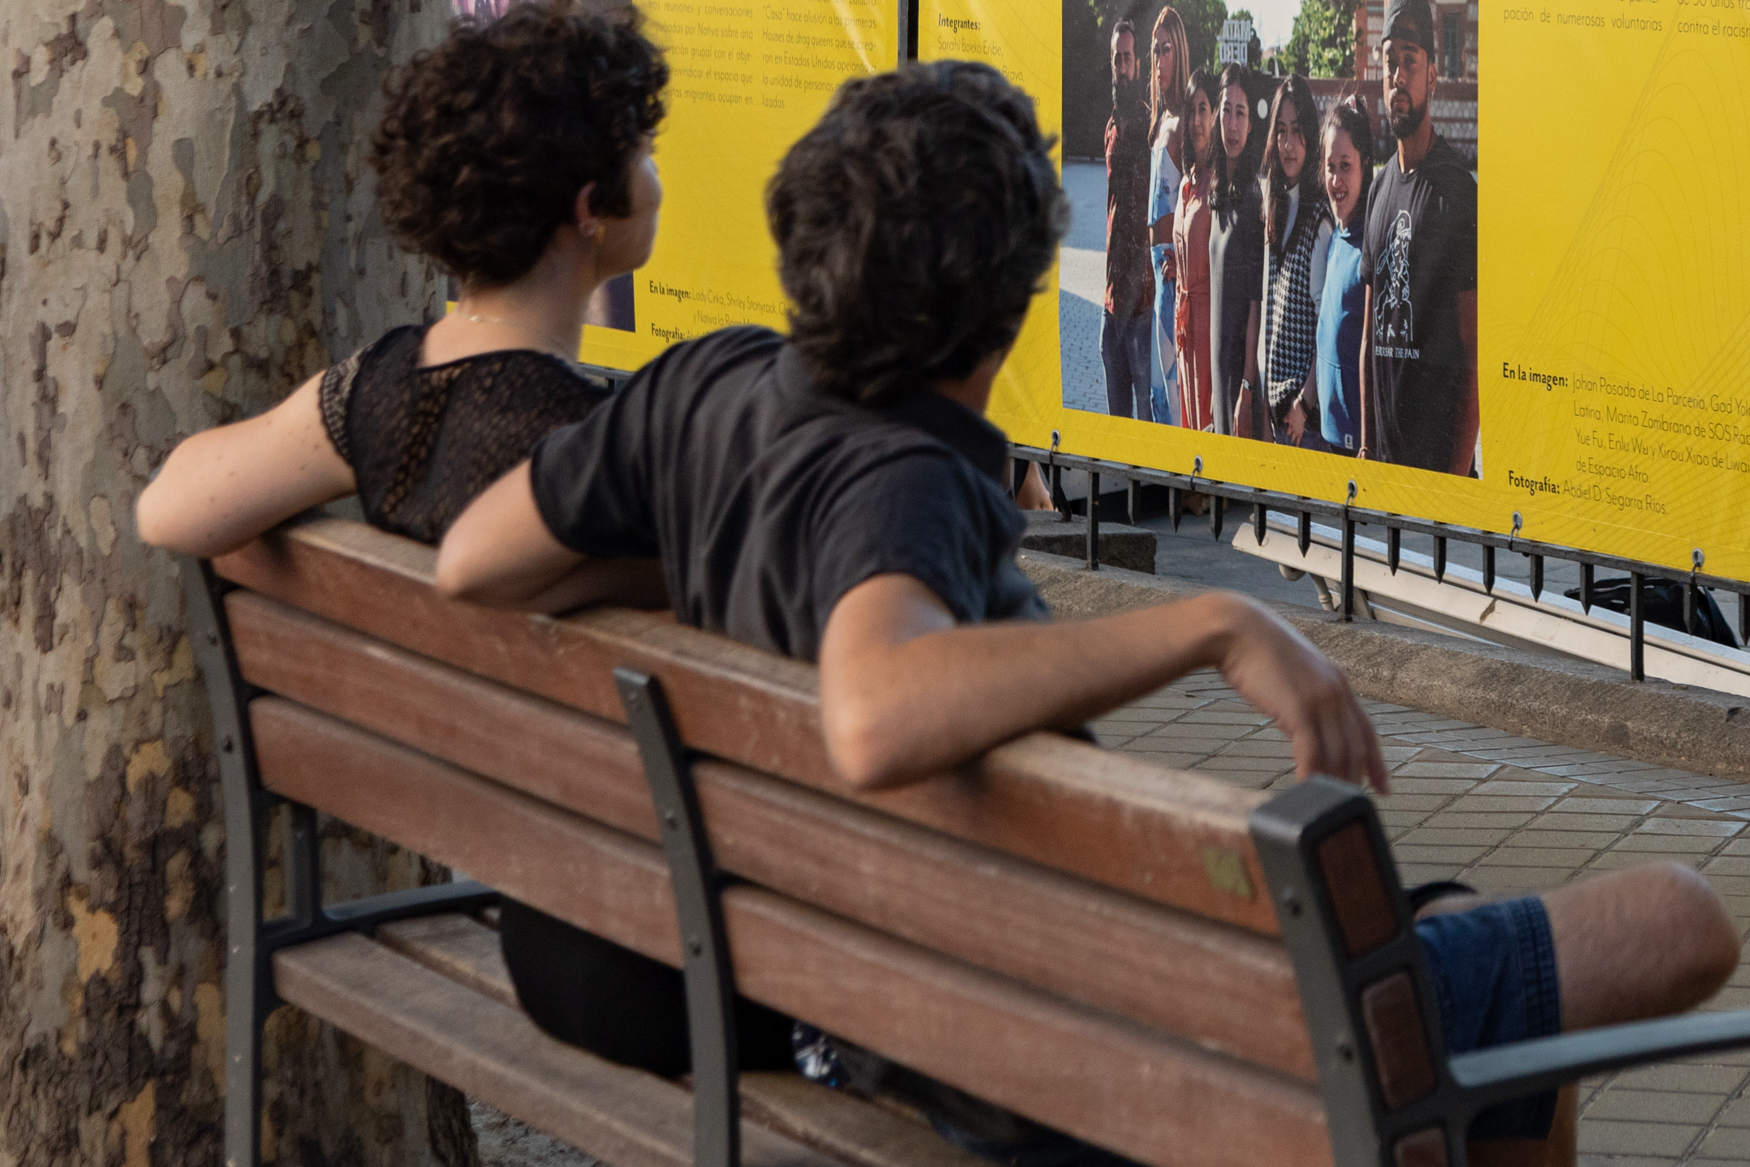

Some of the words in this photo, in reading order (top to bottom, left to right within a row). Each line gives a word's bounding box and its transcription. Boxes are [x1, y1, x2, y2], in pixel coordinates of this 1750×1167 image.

[939, 13, 981, 33] Integrantes:
[1678, 21, 1709, 34] contra
[1712, 20, 1720, 35] el
[1503, 362, 1515, 379] En
[1518, 366, 1526, 381] la
[1529, 368, 1568, 390] imagen:
[1572, 373, 1597, 393] Johan
[1600, 377, 1636, 400] Posada
[1638, 383, 1650, 401] de
[1652, 386, 1664, 403] La
[1710, 394, 1732, 414] Gad
[1574, 401, 1603, 423] Latina,
[1607, 407, 1638, 427] Marita
[1642, 412, 1691, 436] Zambrana
[1694, 420, 1705, 437] de
[1709, 424, 1731, 442] SOS
[1508, 470, 1560, 495] Fotografía:
[1563, 480, 1591, 500] Abdiel
[1606, 488, 1642, 513] Segarra
[1645, 494, 1668, 514] Ríos.
